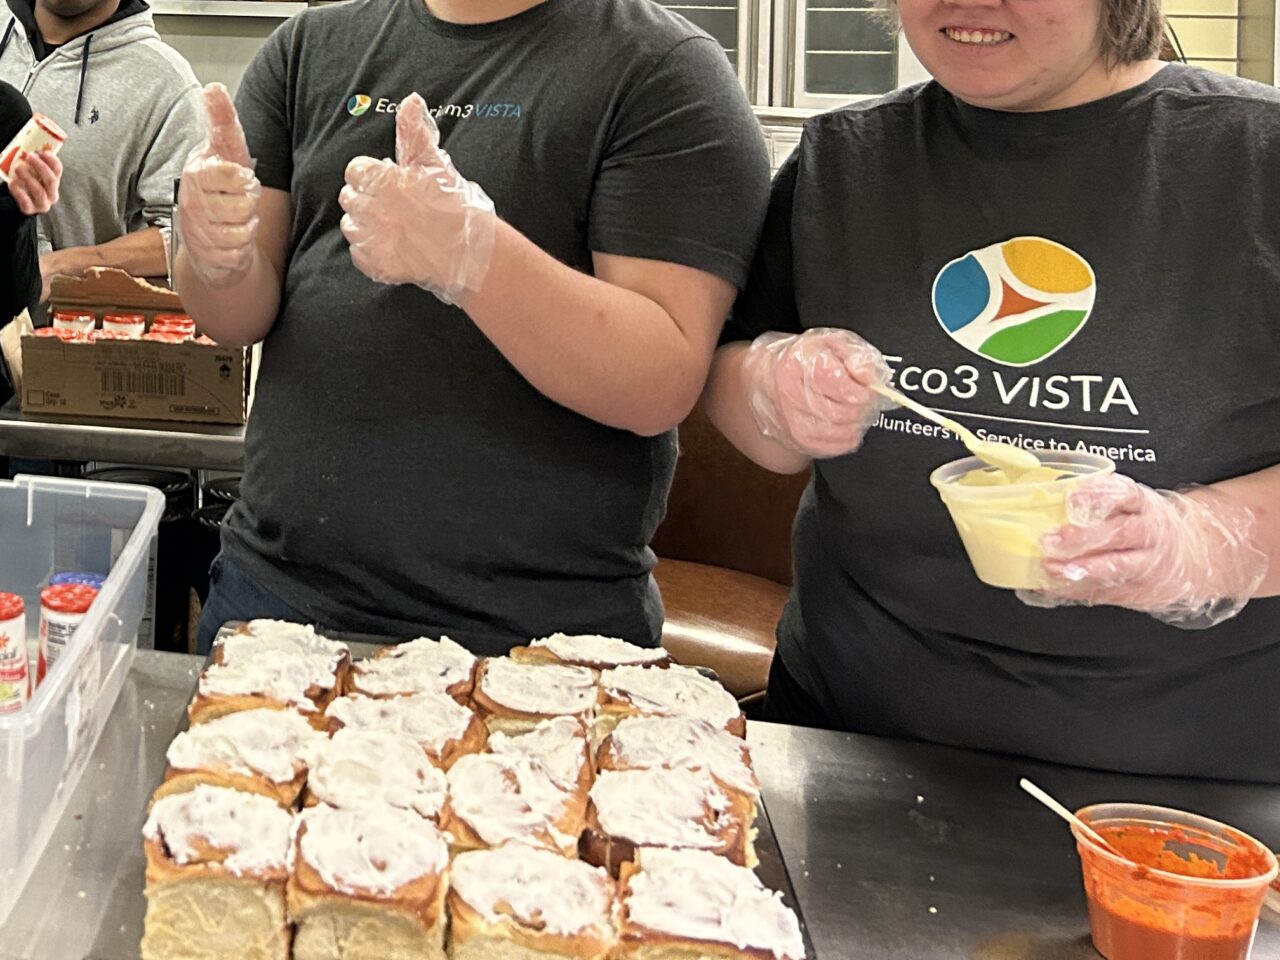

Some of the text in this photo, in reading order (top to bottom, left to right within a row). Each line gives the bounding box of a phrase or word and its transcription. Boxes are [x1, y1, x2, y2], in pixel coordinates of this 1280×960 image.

[475, 103, 522, 119] VISTA
[992, 370, 1140, 416] VISTA
[871, 412, 951, 440] olunteers
[975, 428, 1045, 451] Service
[1049, 437, 1070, 453] to
[1075, 440, 1157, 462] America
